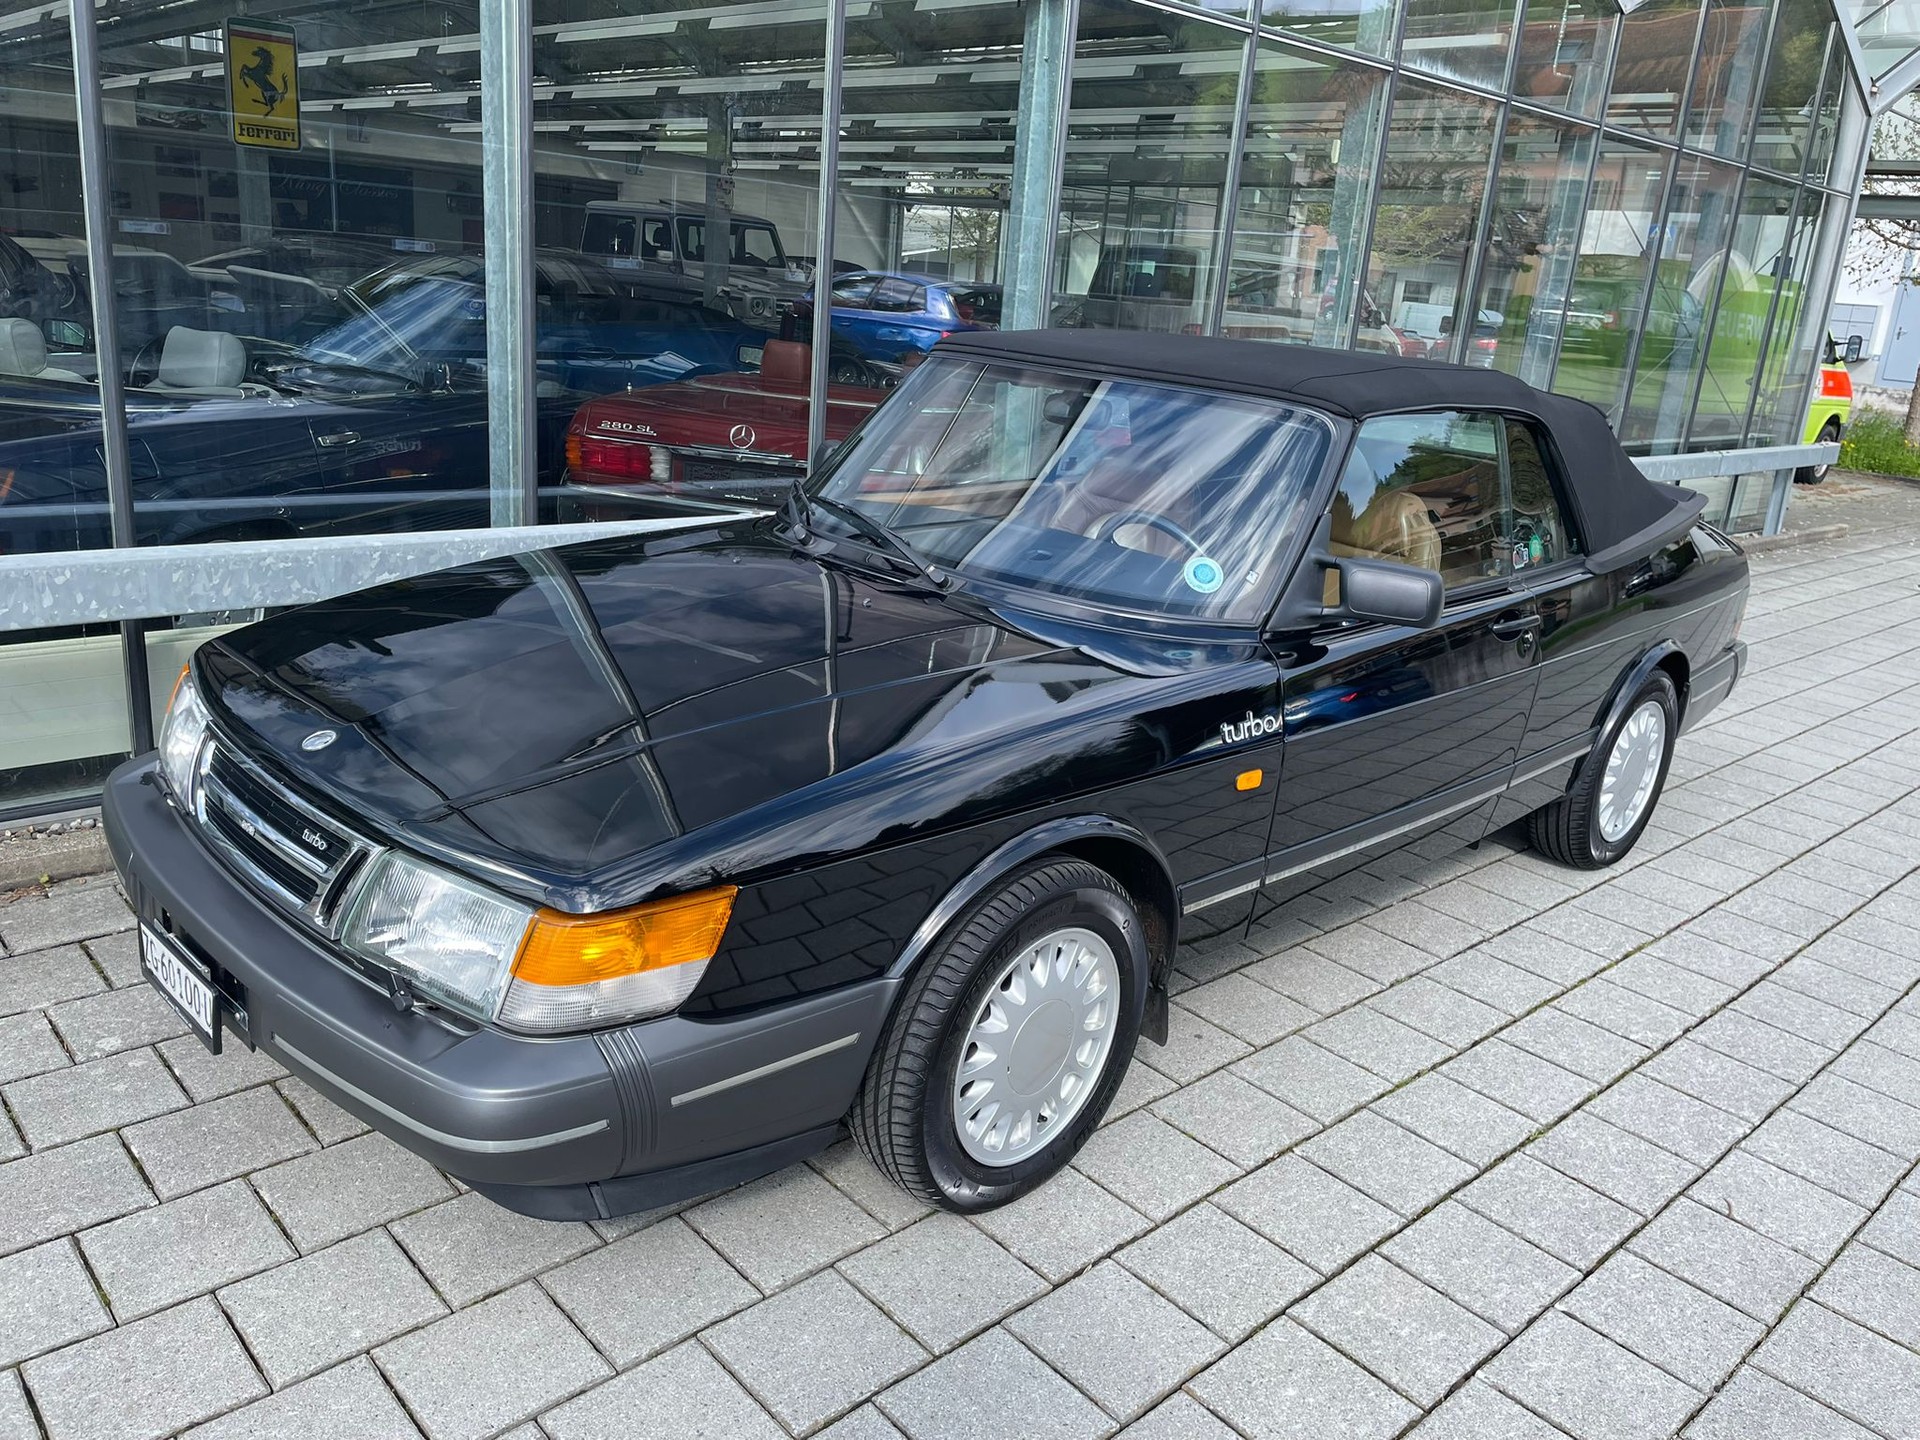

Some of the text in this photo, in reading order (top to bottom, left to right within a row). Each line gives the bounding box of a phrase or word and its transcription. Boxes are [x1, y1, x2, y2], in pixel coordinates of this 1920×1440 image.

[237, 122, 296, 142] Ferrari
[601, 420, 656, 435] 280 SL
[1220, 710, 1277, 743] turbo
[302, 828, 328, 851] turbo
